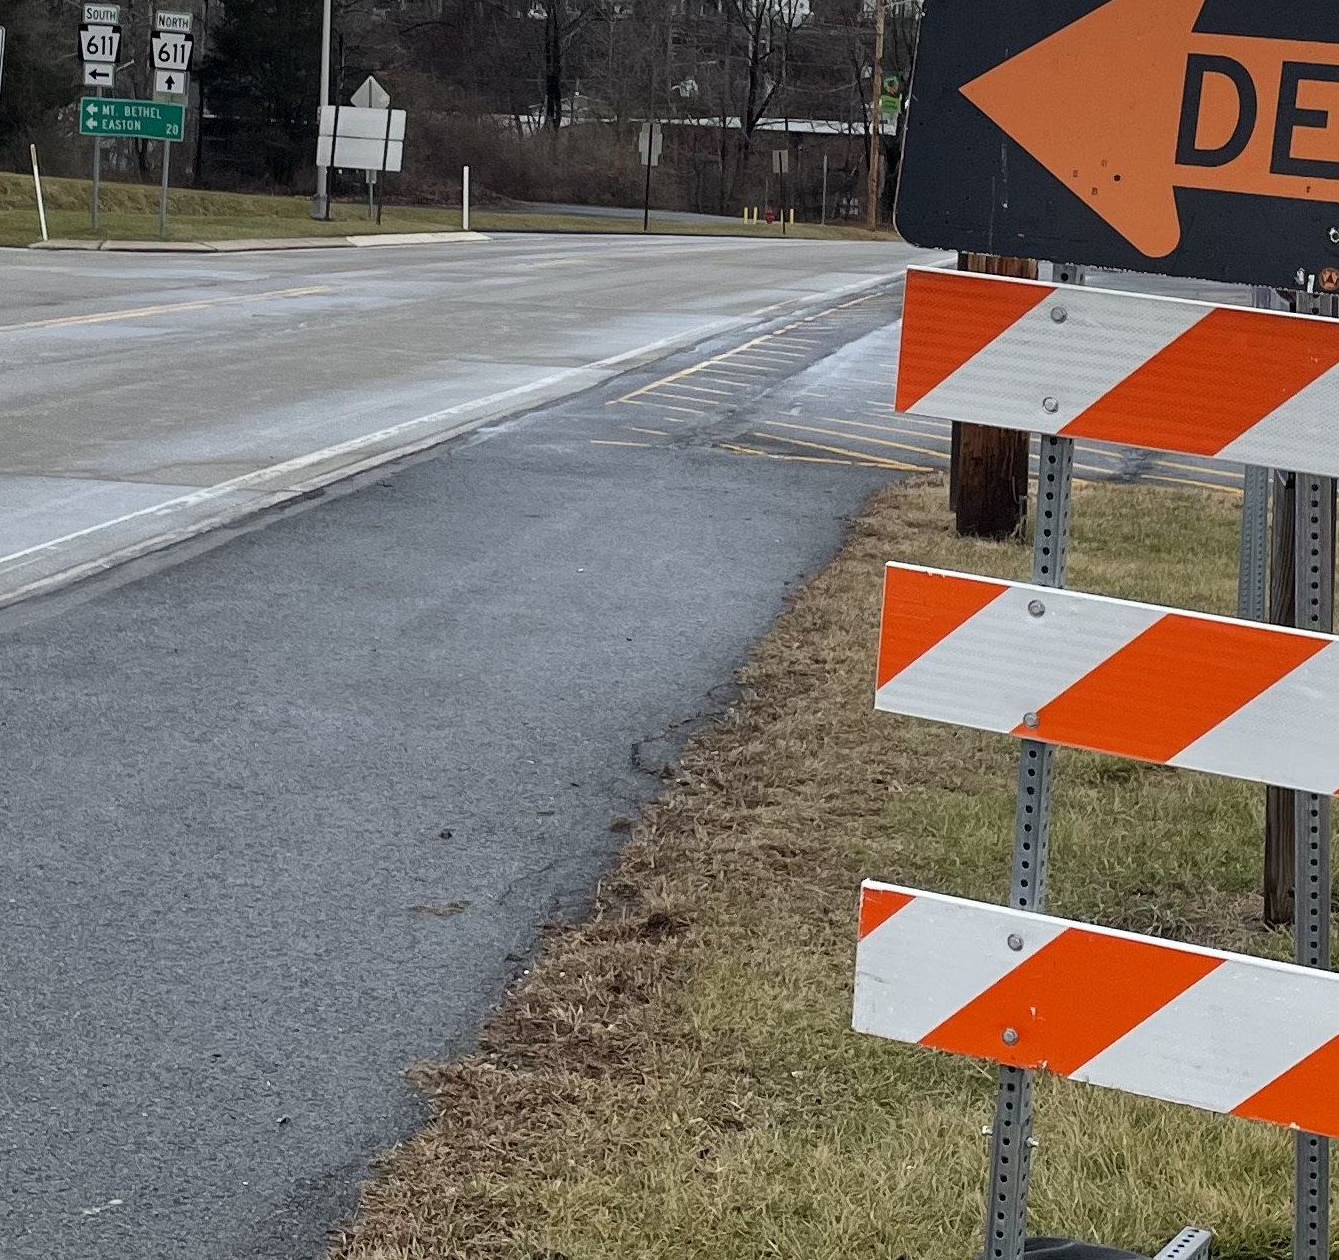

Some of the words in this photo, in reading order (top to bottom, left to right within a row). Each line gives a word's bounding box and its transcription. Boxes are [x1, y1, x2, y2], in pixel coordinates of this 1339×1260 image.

[86, 8, 117, 21] SOUTH
[159, 15, 189, 30] NORTH
[86, 35, 114, 56] 611
[159, 42, 186, 64] 611
[124, 106, 161, 118] BETHEL
[102, 119, 141, 130] EASTON
[166, 124, 178, 135] 20
